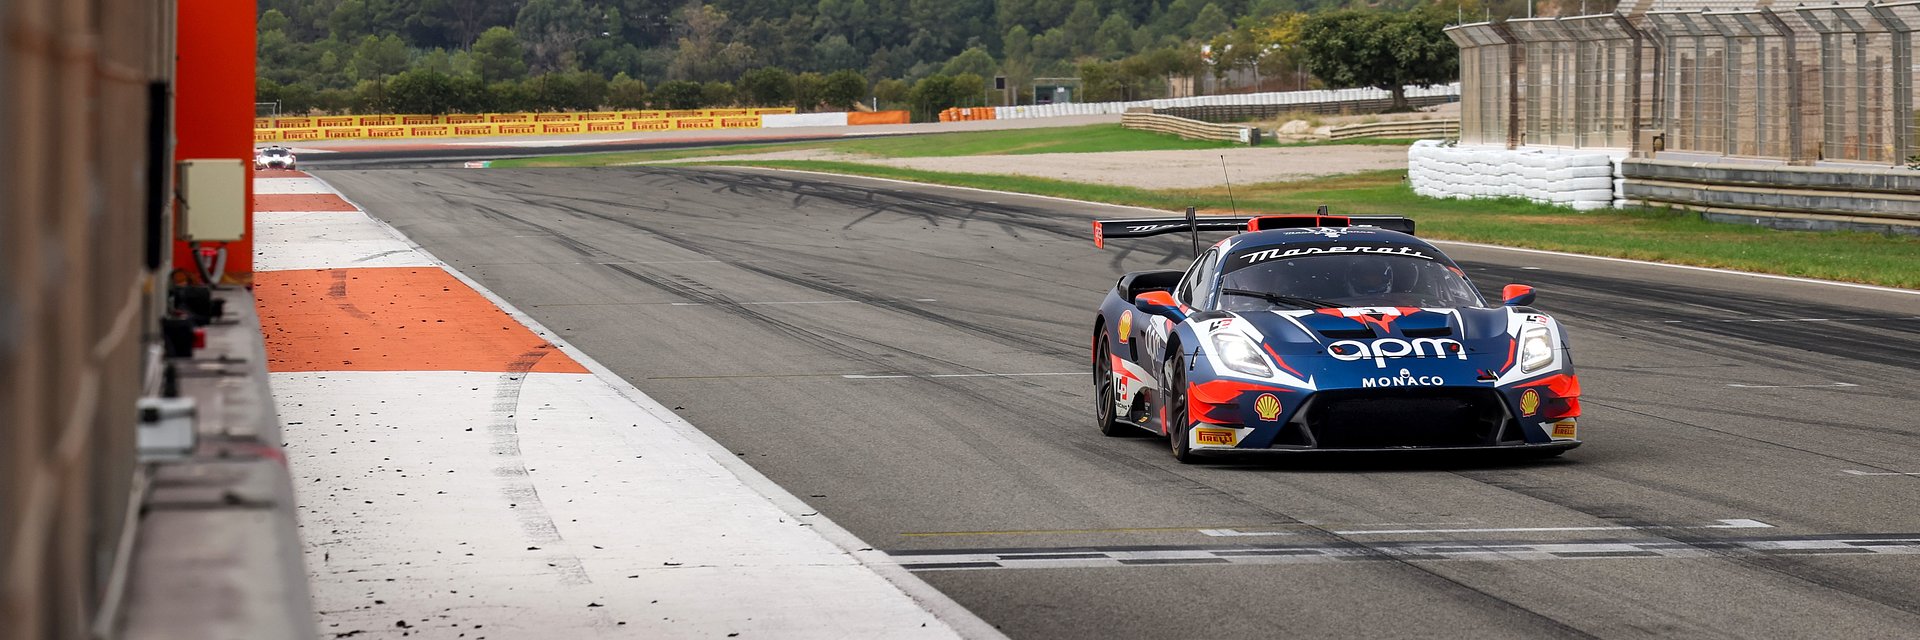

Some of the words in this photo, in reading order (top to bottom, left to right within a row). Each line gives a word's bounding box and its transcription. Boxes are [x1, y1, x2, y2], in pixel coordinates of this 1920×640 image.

[275, 119, 310, 129] PIRELLI
[317, 118, 353, 128] PIRELLI
[588, 122, 624, 132] PIRELLI
[632, 121, 669, 130] PIRELLI
[677, 120, 713, 129] PIRELLI
[722, 118, 758, 128] PIRELLI
[325, 128, 360, 138] PIRELLI
[368, 128, 404, 137] PIRELLI
[412, 127, 447, 136] PIRELLI
[455, 126, 491, 135] PIRELLI
[499, 125, 535, 134] PIRELLI
[543, 124, 579, 133] PIRELLI
[283, 129, 317, 139] PIRELLI
[1239, 246, 1434, 264] Maserati
[1327, 338, 1468, 369] apm
[1362, 375, 1444, 388] MONACO
[1198, 431, 1233, 444] PIRELLI
